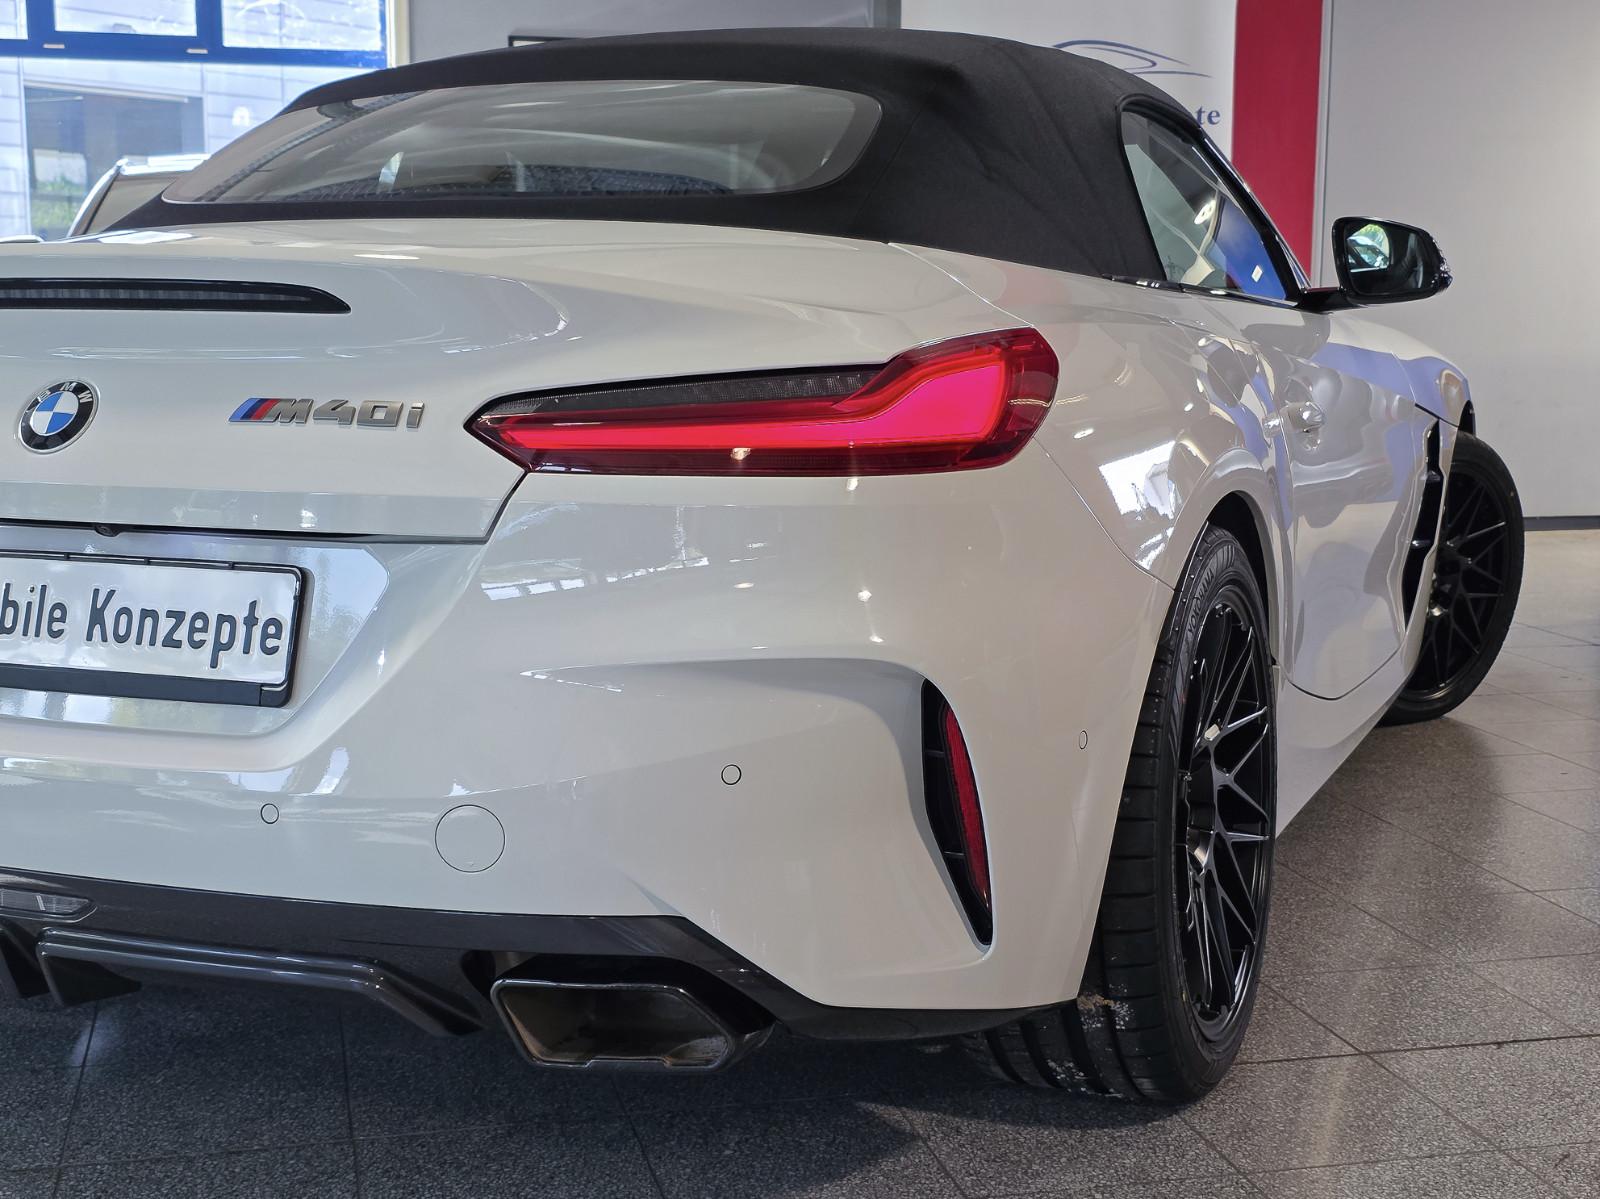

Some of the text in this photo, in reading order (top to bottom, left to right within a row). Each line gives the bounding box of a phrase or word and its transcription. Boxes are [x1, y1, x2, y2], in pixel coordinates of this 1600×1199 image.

[37, 381, 94, 403] BMW
[258, 398, 426, 428] M40i
[0, 582, 283, 669] bile Konzepte
